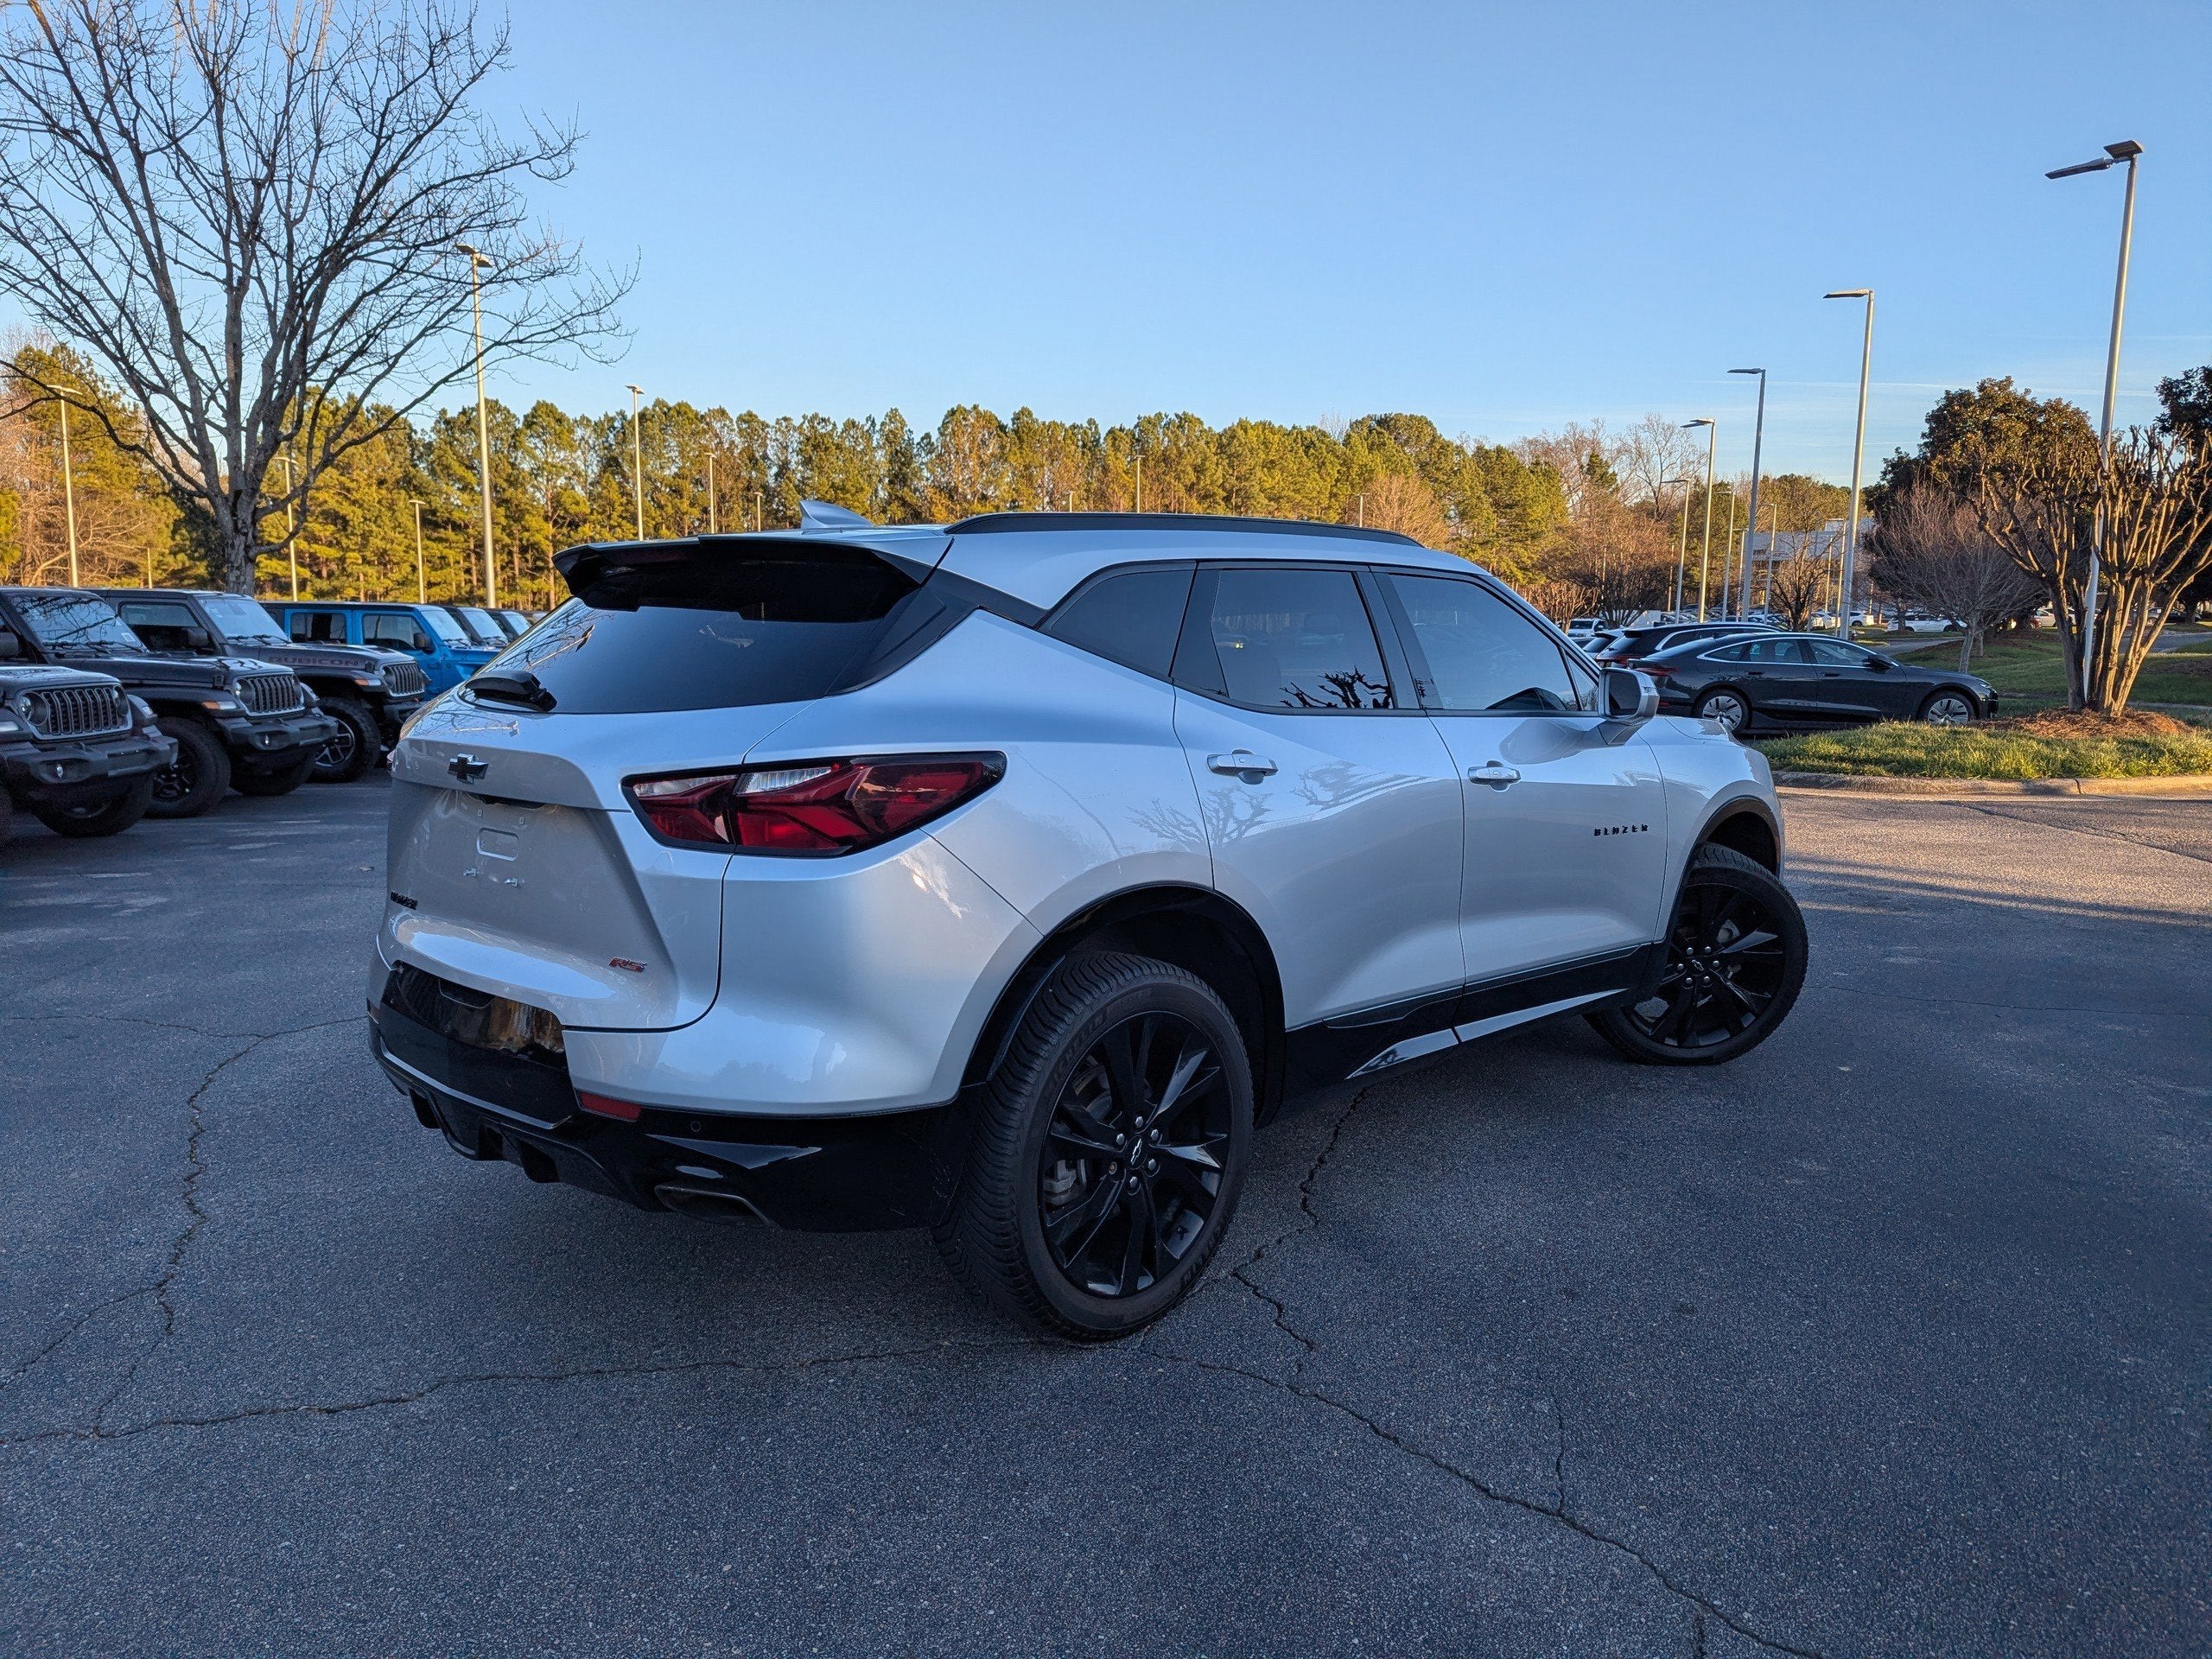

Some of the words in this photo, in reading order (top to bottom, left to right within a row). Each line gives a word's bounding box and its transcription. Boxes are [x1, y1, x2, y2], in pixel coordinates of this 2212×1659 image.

[269, 657, 359, 666] RUBICON
[1593, 823, 1649, 836] BLAZER
[608, 957, 647, 972] RS
